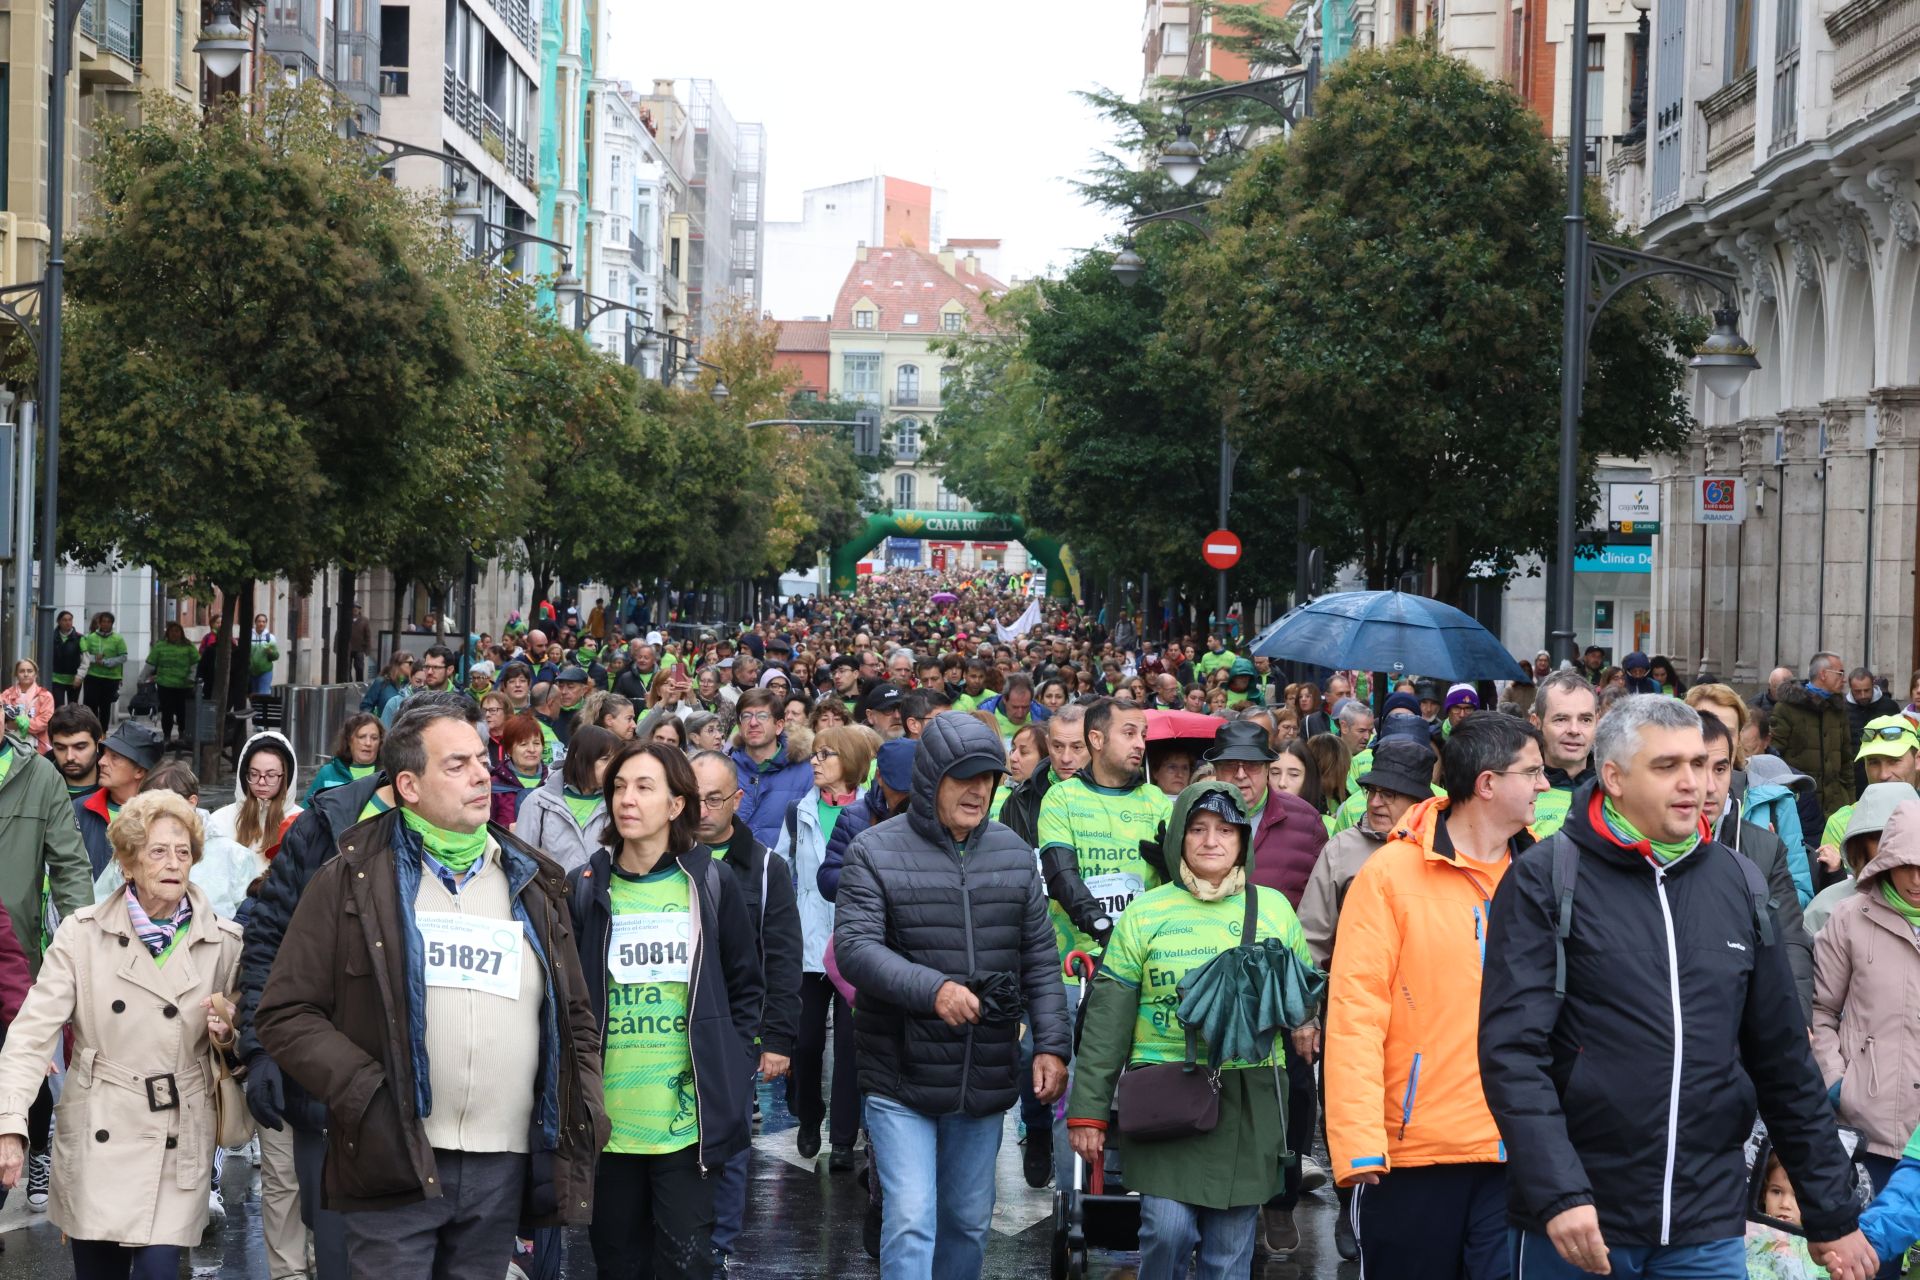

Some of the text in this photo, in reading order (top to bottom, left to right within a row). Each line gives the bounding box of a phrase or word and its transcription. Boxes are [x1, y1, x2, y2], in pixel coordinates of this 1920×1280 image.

[926, 518, 960, 532] CAJA
[1600, 551, 1634, 564] Clínica
[1088, 844, 1141, 861] marc
[428, 940, 503, 976] 51827
[619, 941, 689, 967] 50814
[1164, 945, 1218, 959] Valladolid
[1148, 967, 1176, 987] En
